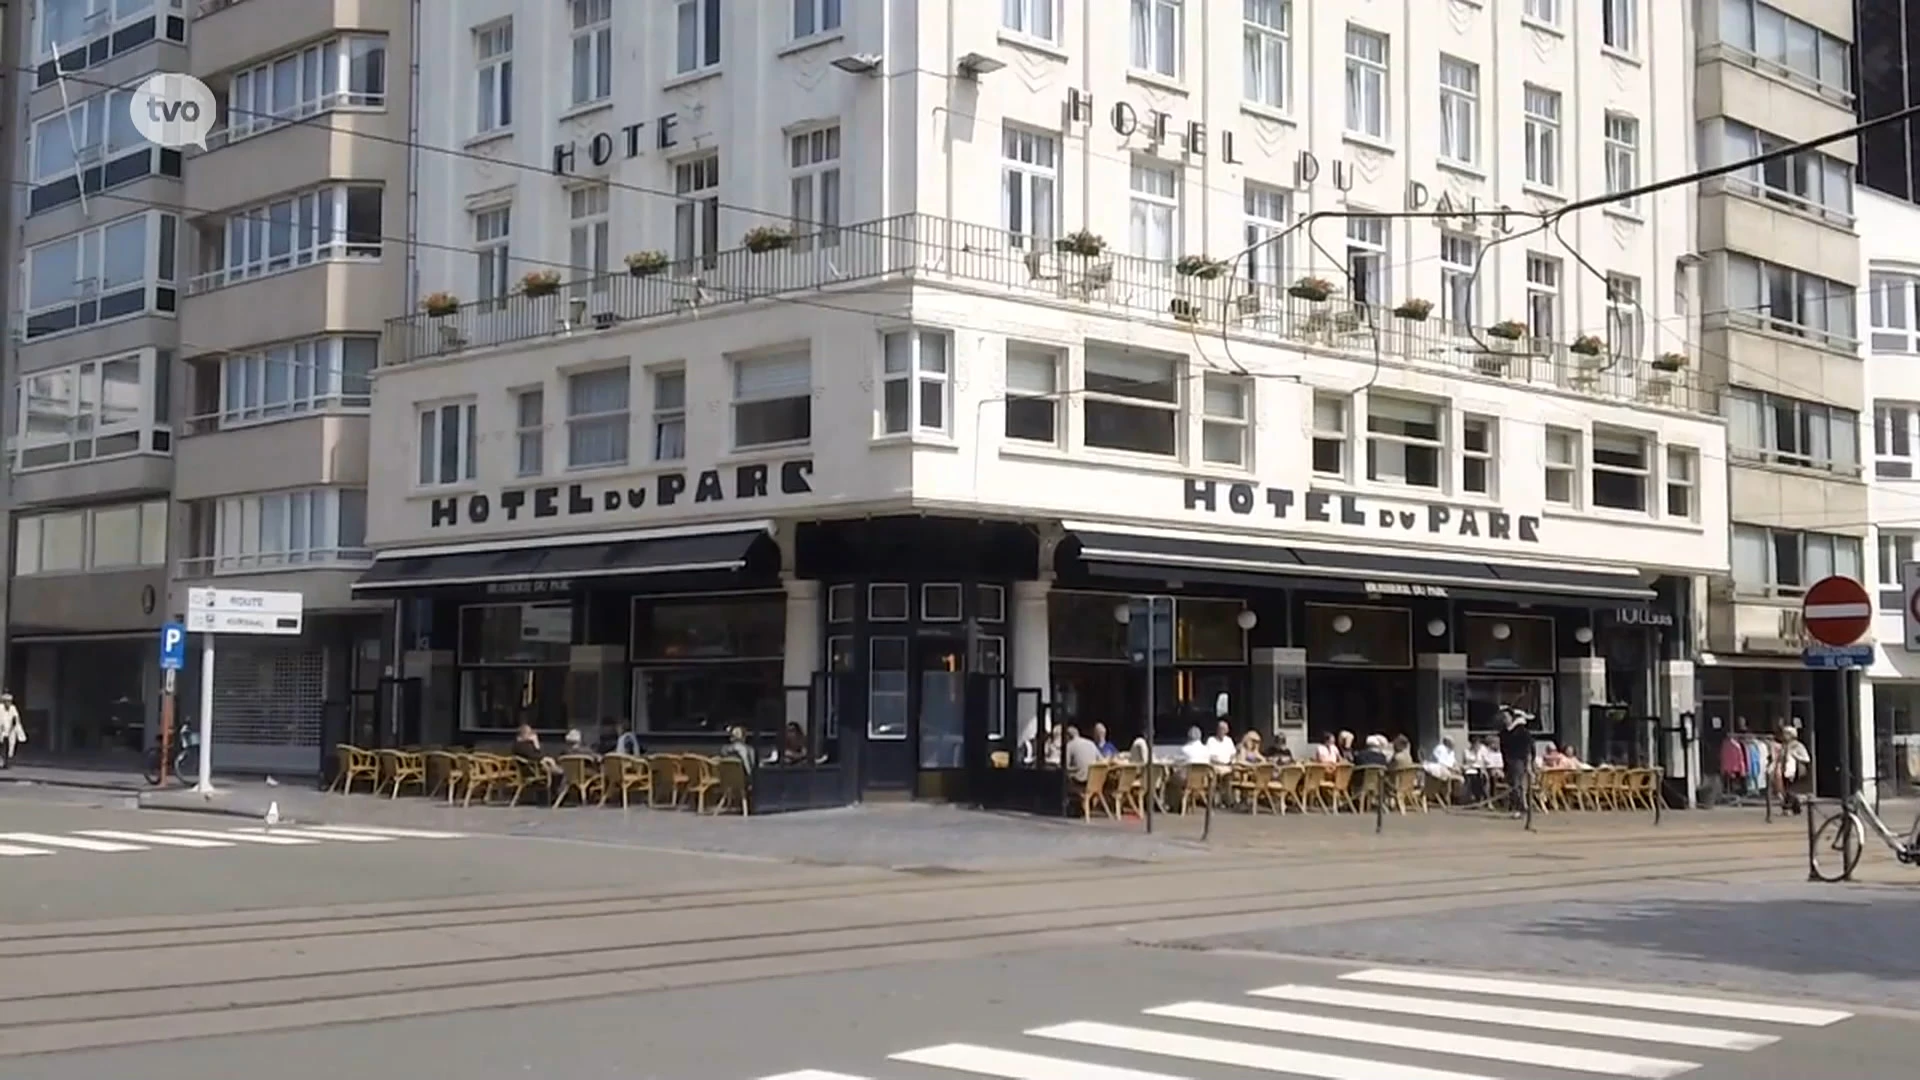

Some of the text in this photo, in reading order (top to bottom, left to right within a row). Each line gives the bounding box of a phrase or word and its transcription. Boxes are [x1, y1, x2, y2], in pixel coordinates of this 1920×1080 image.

[553, 112, 678, 176] HOTE
[1068, 87, 1243, 165] HOTEL
[1298, 149, 1353, 192] DU
[432, 460, 813, 528] HOTEL DU PARC
[1184, 478, 1539, 543] HOTEL DU PARC
[165, 628, 181, 653] P
